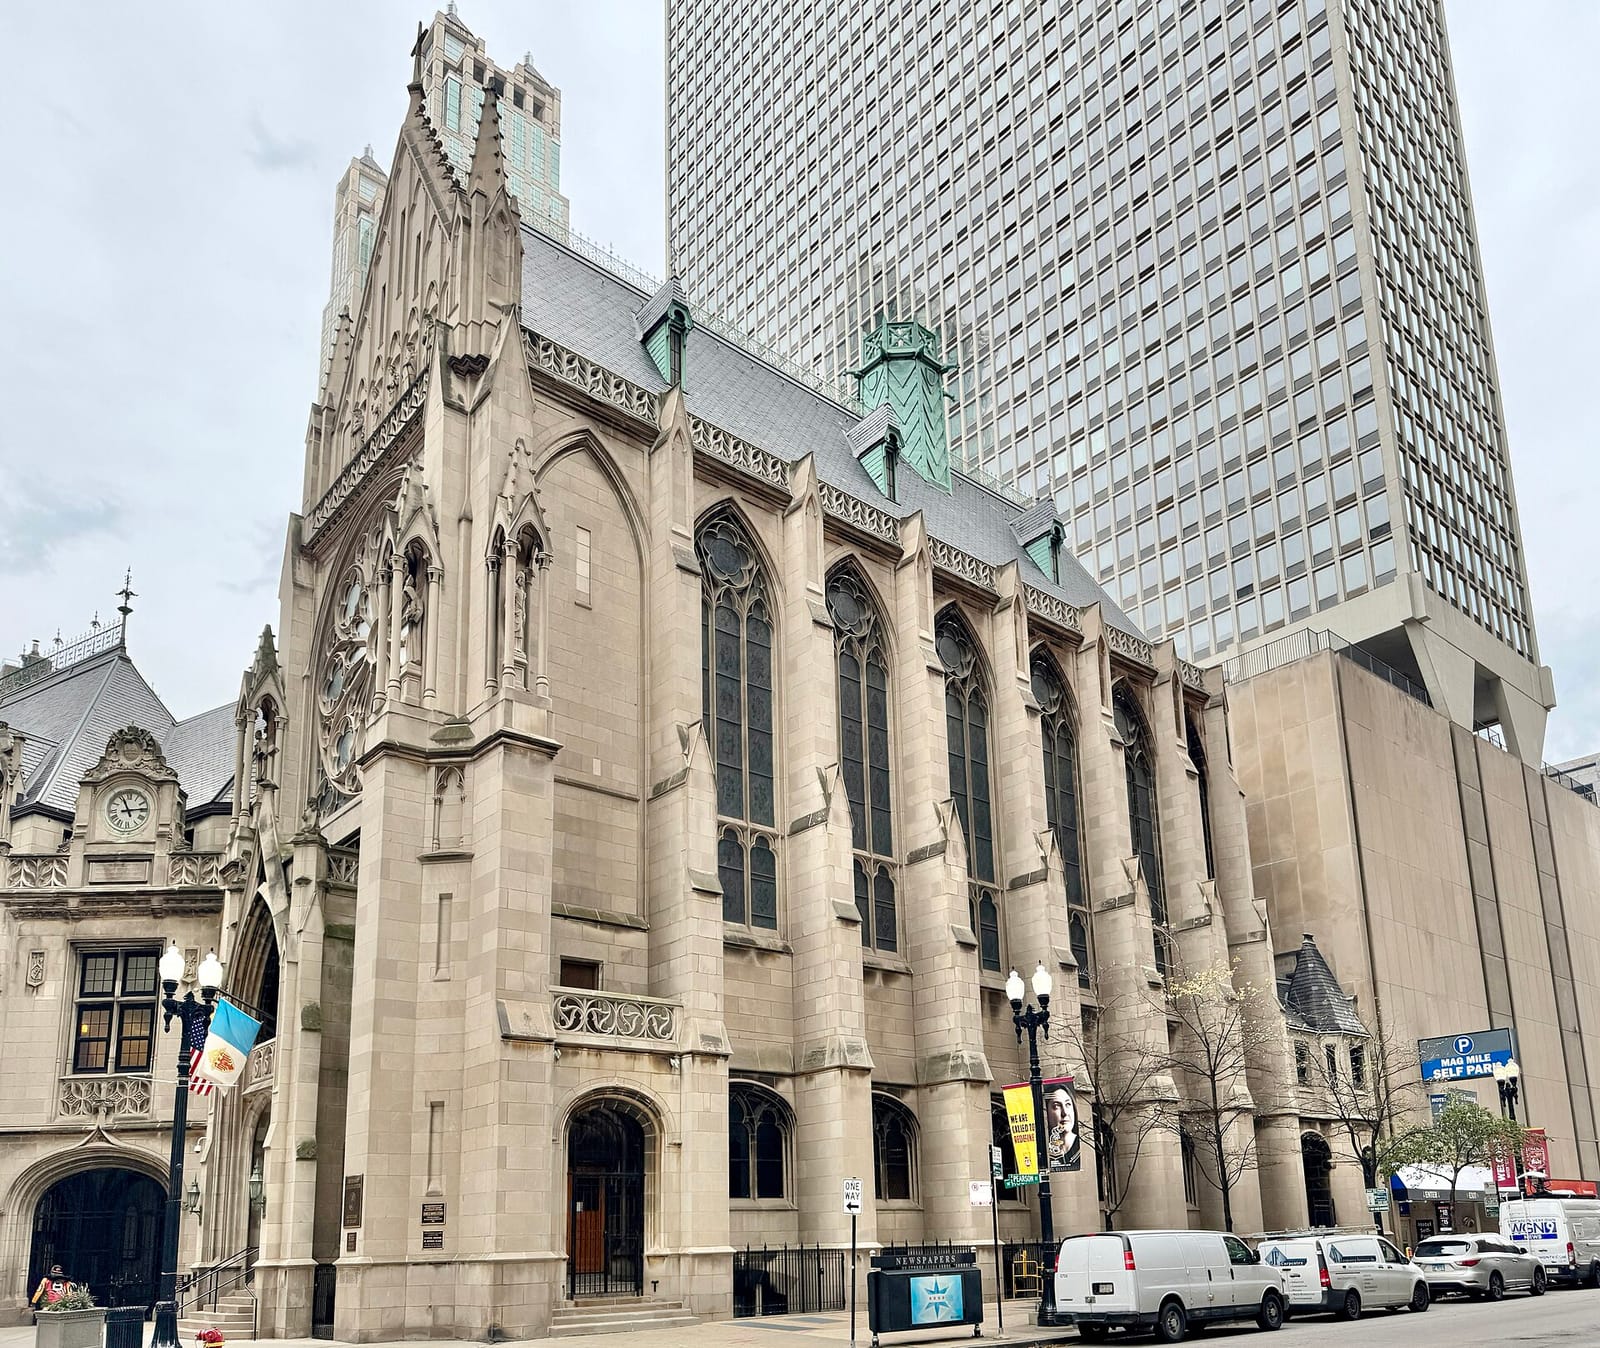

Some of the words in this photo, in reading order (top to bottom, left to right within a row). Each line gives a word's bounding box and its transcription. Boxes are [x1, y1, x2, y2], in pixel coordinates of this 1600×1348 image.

[1458, 1038, 1470, 1052] P
[1441, 1057, 1464, 1067] MAG
[1466, 1053, 1491, 1064] MILE
[1433, 1066, 1463, 1079] SELF
[1019, 1113, 1028, 1122] ARE
[845, 1182, 860, 1191] ONE
[845, 1192, 860, 1200] WAY
[895, 1255, 956, 1266] NEWSPAPERS
